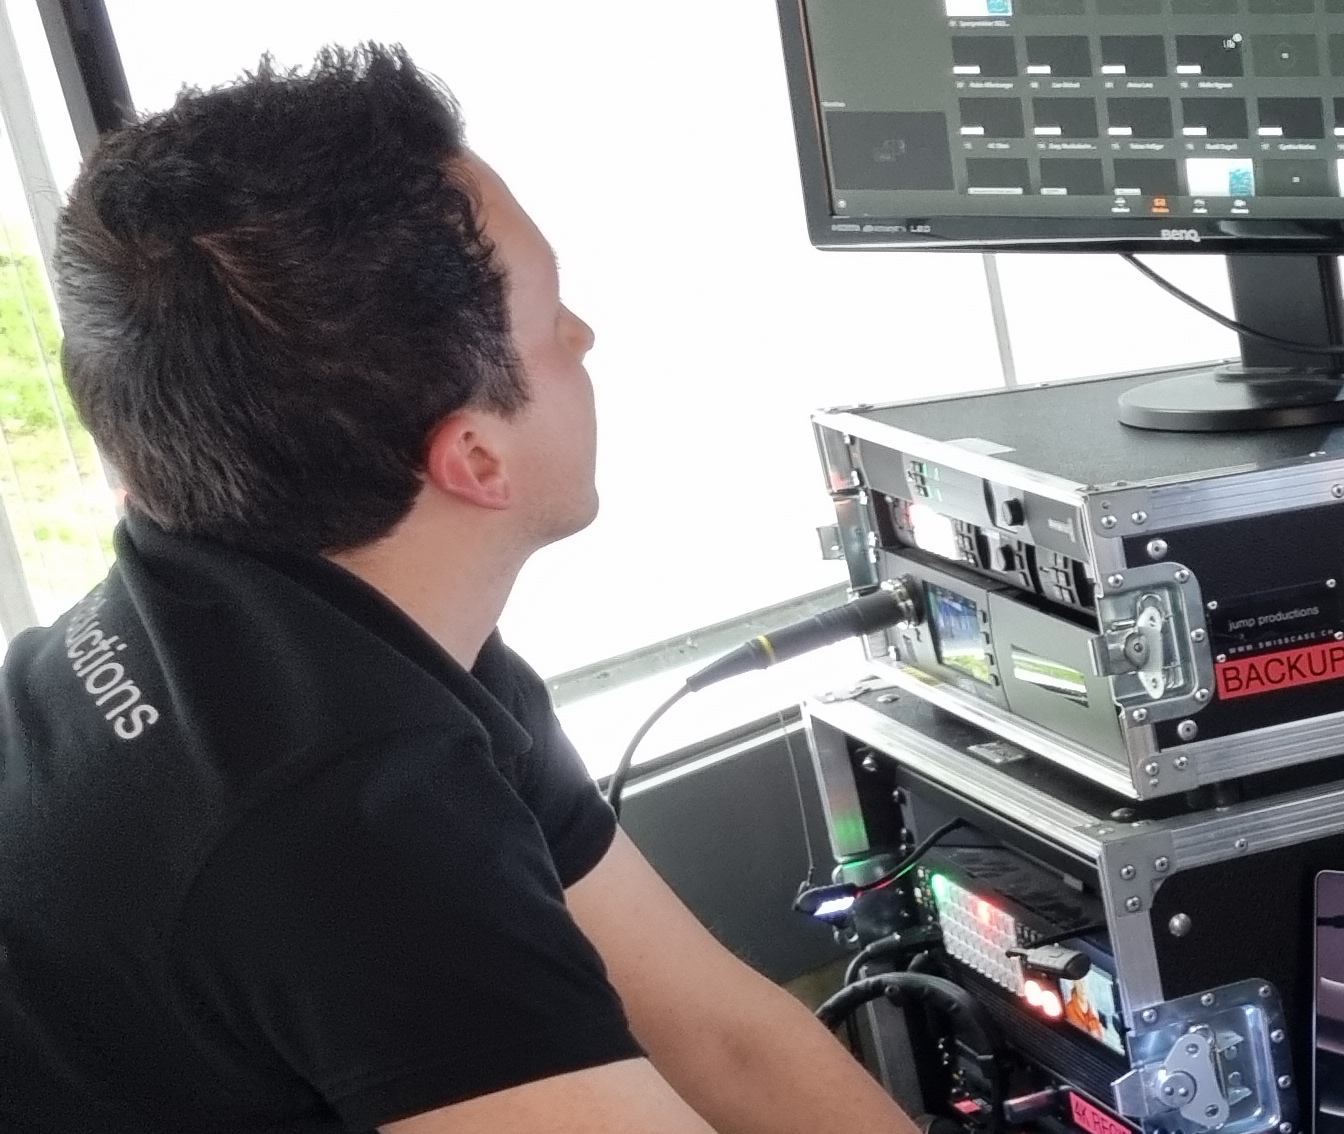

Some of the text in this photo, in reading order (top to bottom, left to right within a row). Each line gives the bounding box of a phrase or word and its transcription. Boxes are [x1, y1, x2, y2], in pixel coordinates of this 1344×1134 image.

[1228, 606, 1320, 632] jump productions
[1075, 1102, 1090, 1127] 4K
